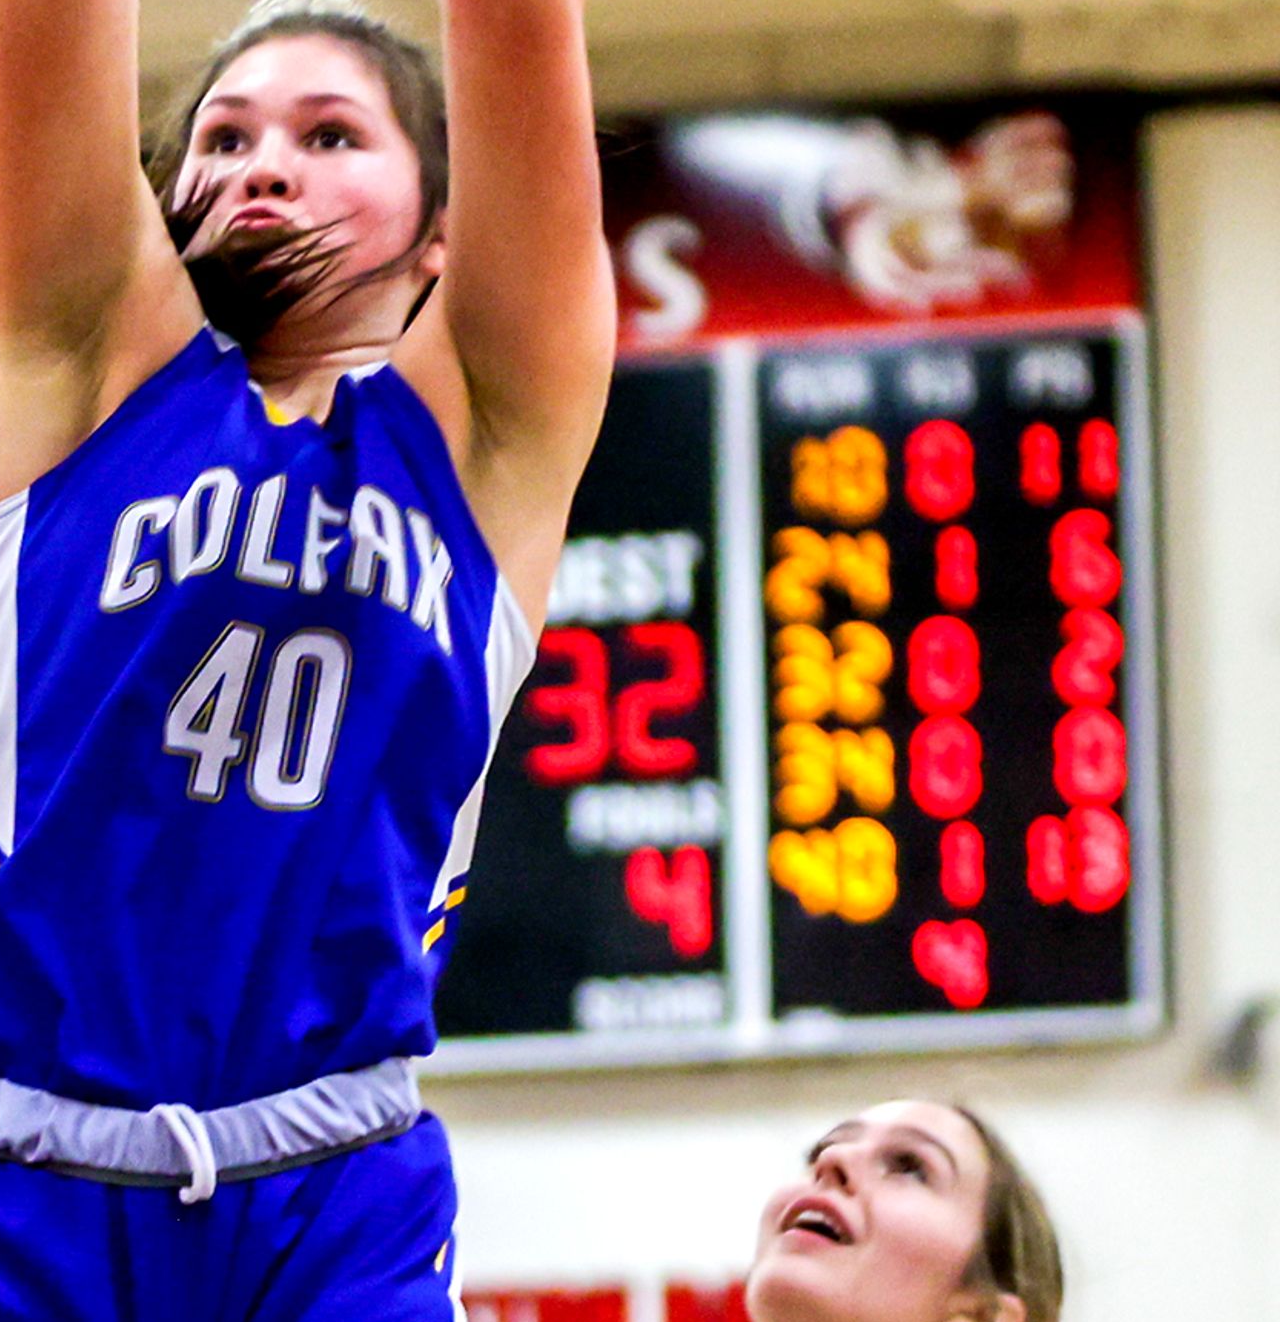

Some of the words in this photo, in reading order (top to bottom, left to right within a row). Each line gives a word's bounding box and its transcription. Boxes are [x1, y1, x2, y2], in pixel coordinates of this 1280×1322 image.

[902, 418, 976, 522] 0
[1018, 418, 1122, 502] 11
[98, 464, 454, 656] COLFAX
[764, 526, 892, 624] 24
[934, 524, 980, 610] 1
[1048, 508, 1124, 610] 6
[162, 619, 354, 812] 40
[525, 620, 705, 786] 32
[775, 620, 894, 724] 32
[906, 615, 982, 715] 0
[1051, 606, 1126, 708] 2
[908, 715, 984, 819] 0
[1052, 706, 1128, 808] 0
[624, 842, 714, 958] 4
[766, 816, 898, 924] 40
[938, 820, 986, 910] 1
[910, 918, 990, 1010] 4
